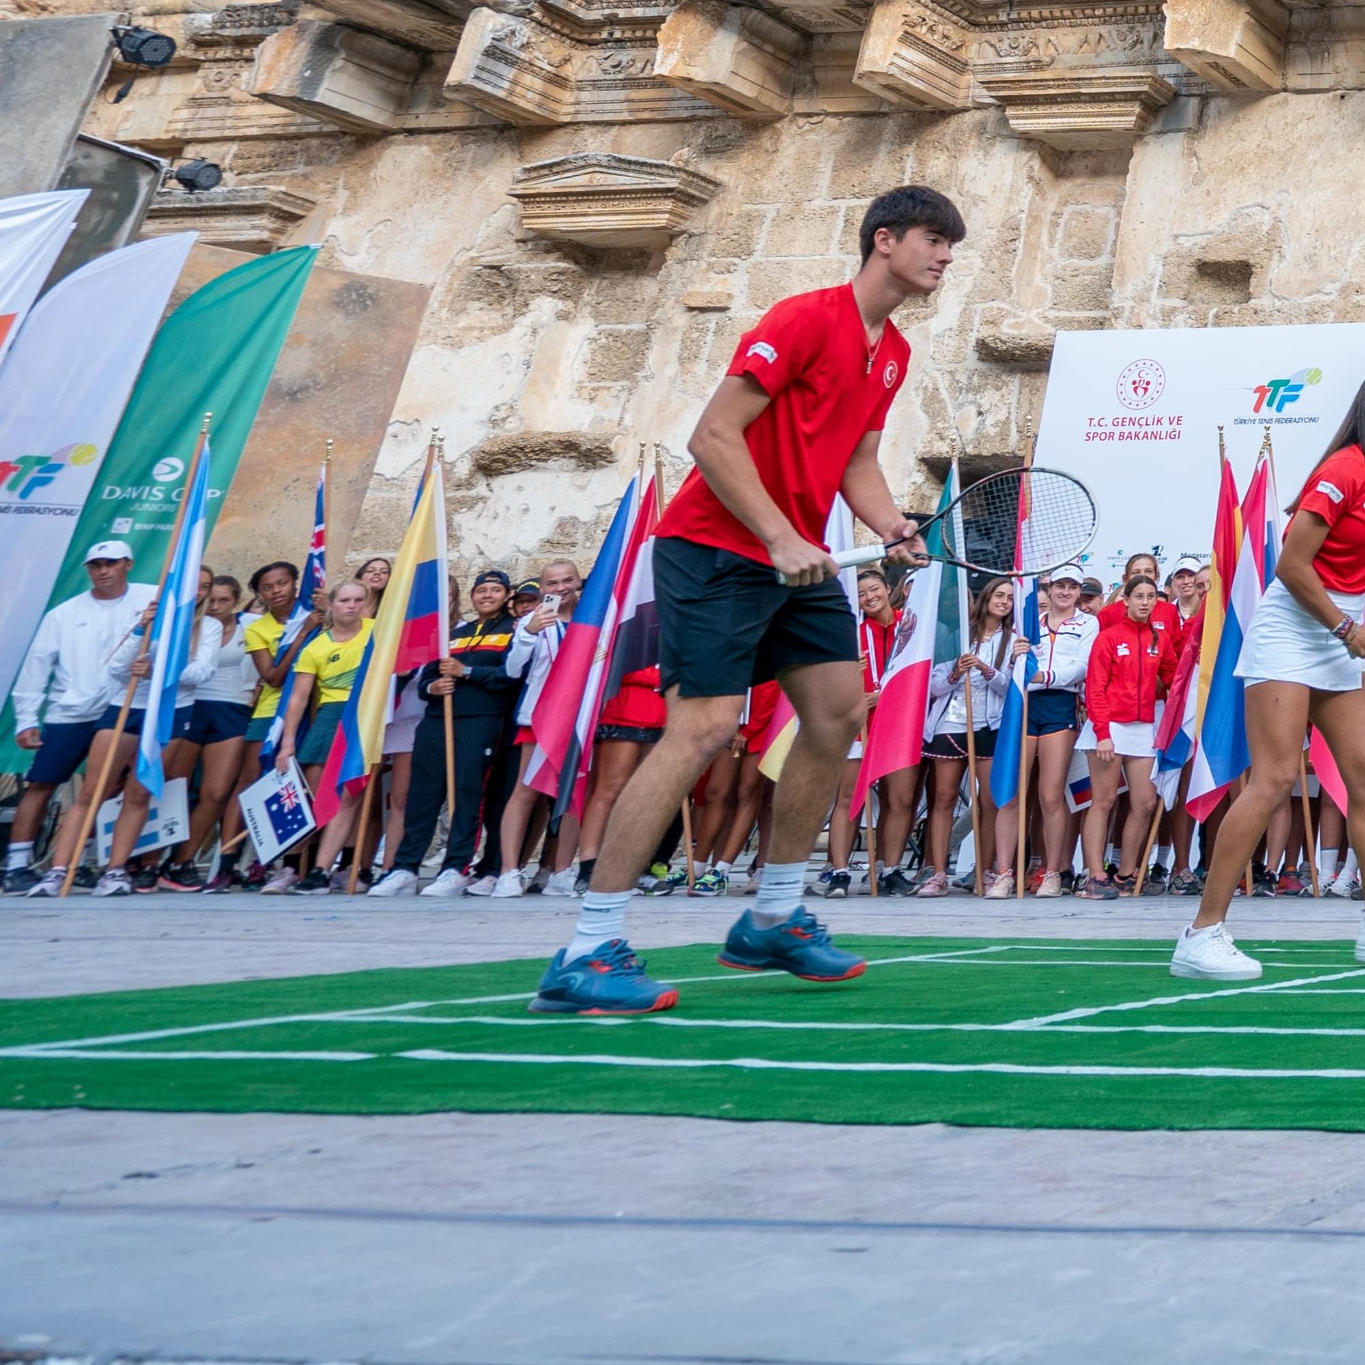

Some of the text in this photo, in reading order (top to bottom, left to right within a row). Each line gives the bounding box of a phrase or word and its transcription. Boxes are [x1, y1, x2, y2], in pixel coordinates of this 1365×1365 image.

[1252, 379, 1304, 414] TTF
[1088, 414, 1184, 429] T.C. GENÇLİK VE
[1233, 417, 1257, 426] TÜRKİYE
[1274, 416, 1320, 424] FEDERASYONU
[1085, 428, 1181, 442] SPOR BAKANLIĞI
[102, 485, 221, 502] DAVIS CP
[246, 808, 264, 848] AUSTRALIA
